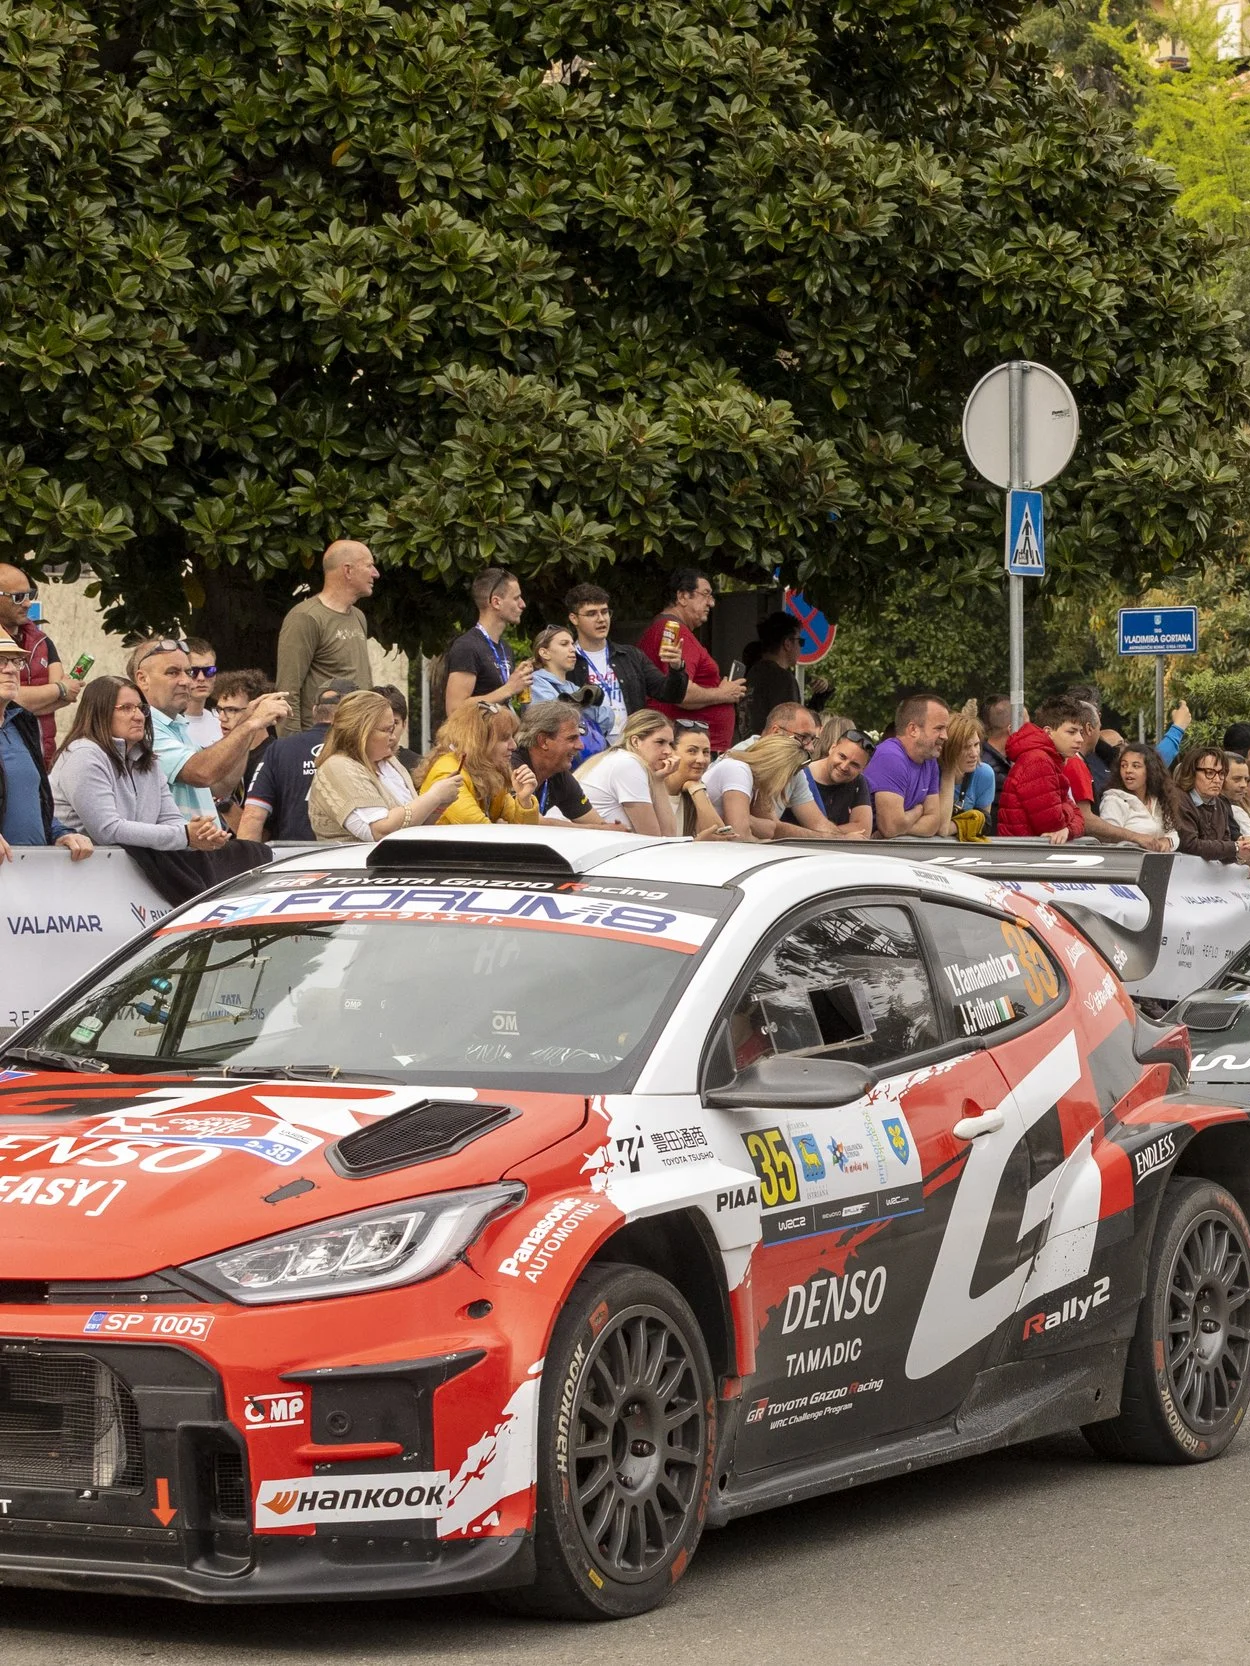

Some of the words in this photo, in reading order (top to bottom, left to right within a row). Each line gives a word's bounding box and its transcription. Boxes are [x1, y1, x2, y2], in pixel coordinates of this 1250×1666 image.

[1124, 635, 1159, 643] VLADIMIRA
[1160, 634, 1192, 642] GORTANA
[323, 877, 436, 885] TOYOTA
[439, 877, 554, 889] GAZOO
[556, 881, 669, 900] Racing
[7, 914, 103, 934] VALAMAR
[270, 889, 677, 933] FORUM8
[944, 953, 1008, 997] Y.Yamamoto
[221, 993, 241, 1005] TATA
[960, 999, 1001, 1035] J.Fulton
[265, 1144, 296, 1161] 35
[662, 1155, 689, 1166] TOYOTA
[688, 1151, 715, 1163] TSUSHO
[747, 1130, 798, 1206] 35
[1135, 1133, 1176, 1177] ENDLESS
[716, 1186, 758, 1212] PIAA
[498, 1196, 581, 1277] Panasonic
[524, 1201, 600, 1284] AUTOMOTIVE
[781, 1266, 886, 1335] DENSO
[1022, 1276, 1111, 1342] Rally2
[85, 1322, 101, 1330] EST
[104, 1313, 144, 1331] SP
[151, 1315, 207, 1336] 1005
[786, 1337, 863, 1378] TAMADIC
[244, 1397, 305, 1422] OMP
[767, 1398, 808, 1416] TOYOTA
[809, 1387, 848, 1405] GAZOO
[848, 1378, 884, 1396] Racing
[770, 1418, 788, 1431] WRC
[788, 1410, 824, 1425] Challenge
[824, 1402, 854, 1416] Program
